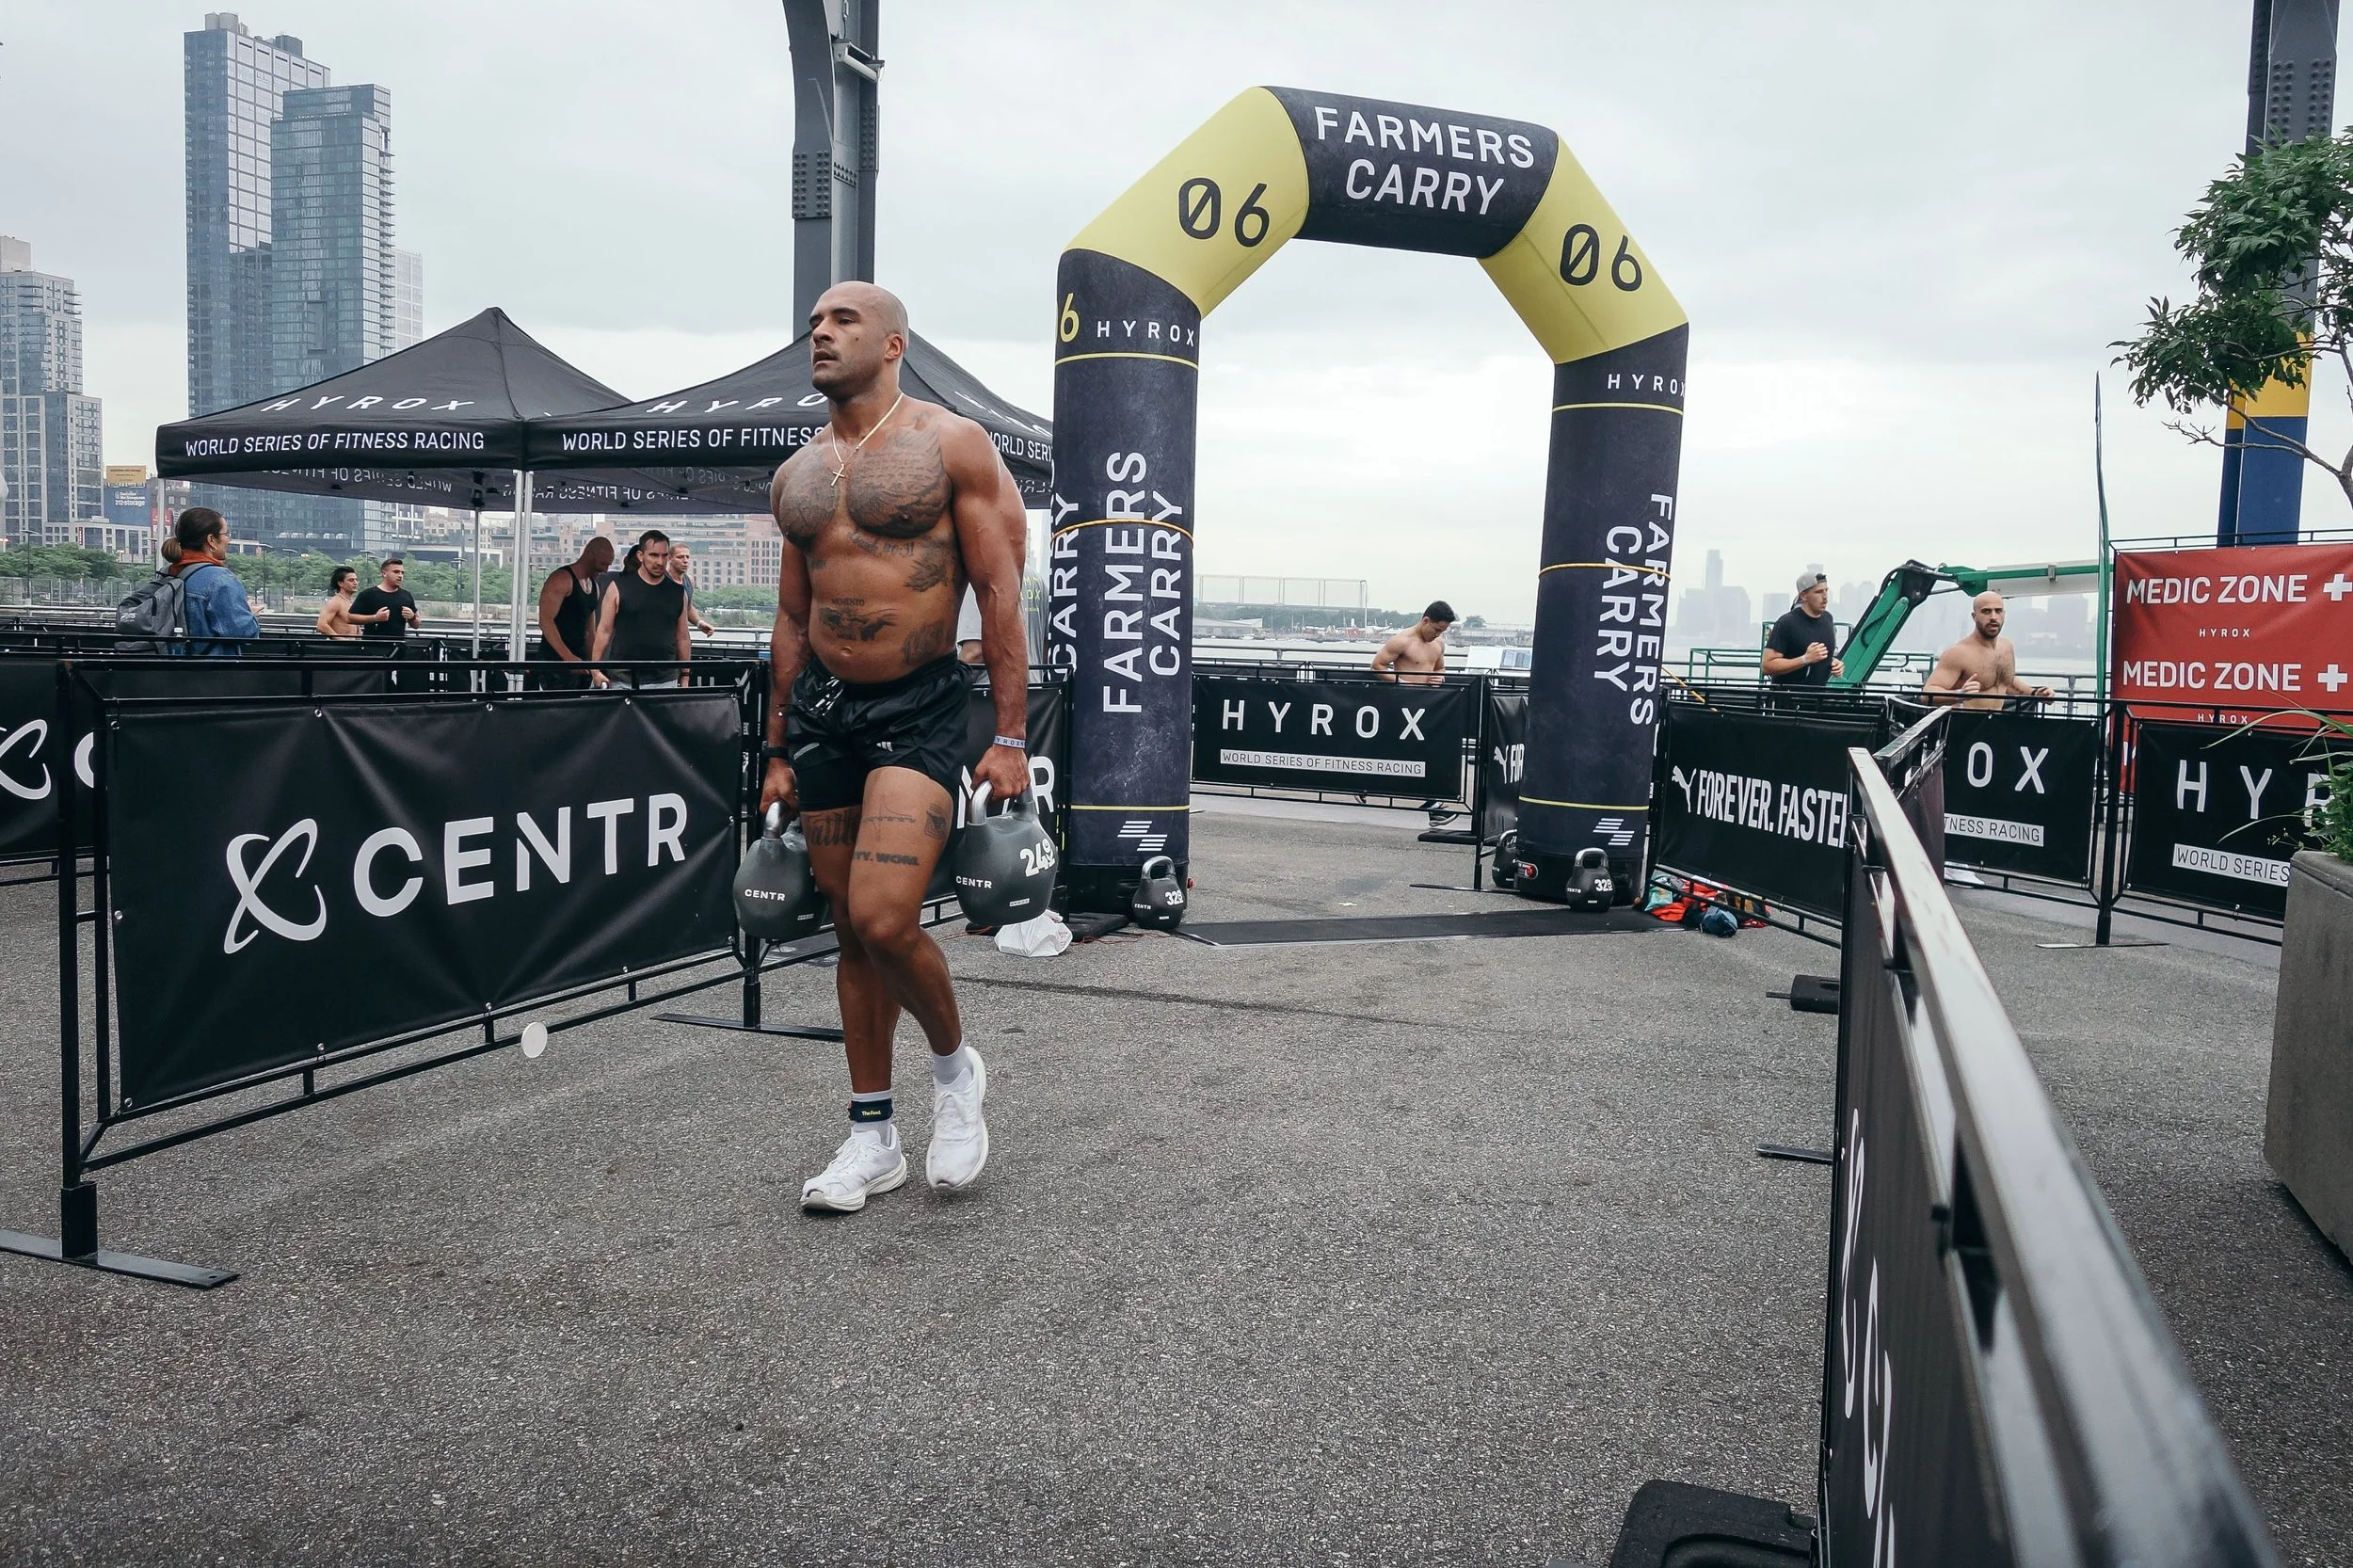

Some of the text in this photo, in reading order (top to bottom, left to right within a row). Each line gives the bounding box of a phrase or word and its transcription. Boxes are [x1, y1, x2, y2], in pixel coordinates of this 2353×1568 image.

[1314, 106, 1534, 169] FARMERS
[1346, 158, 1504, 216] CARRY
[1177, 177, 1270, 248] 06
[1559, 223, 1643, 292] 06
[1096, 319, 1195, 347] HYROX
[260, 395, 475, 412] HYROX
[646, 392, 828, 413] HYRO
[185, 431, 485, 456] WORLD SERIES OF FITNESS RACING
[562, 432, 627, 451] WORLD
[632, 429, 701, 449] SERIES
[708, 428, 734, 447] OF
[990, 432, 1052, 462] ORLD SERI
[1051, 492, 1080, 684] CARRY
[1103, 451, 1147, 713] FARMERS
[1148, 489, 1183, 677] CARRY
[2125, 573, 2308, 605] MEDIC ZONE
[1593, 524, 1642, 693] CARRY
[1629, 493, 1673, 726] FARMERS
[2198, 628, 2250, 638] HYROX
[2122, 660, 2302, 692] MEDIC ZONE
[1222, 698, 1426, 741] HYROX
[2198, 712, 2248, 725] HYROX
[1223, 752, 1422, 775] WORLD SERIES OF FITNESS RACING
[1696, 769, 1774, 832] FOREVER.
[1945, 816, 2040, 842] TNESS RACING
[353, 792, 688, 918] CENTR
[2177, 847, 2290, 882] WORLD SERIES
[744, 888, 786, 901] CENTR
[955, 875, 992, 888] CENTR
